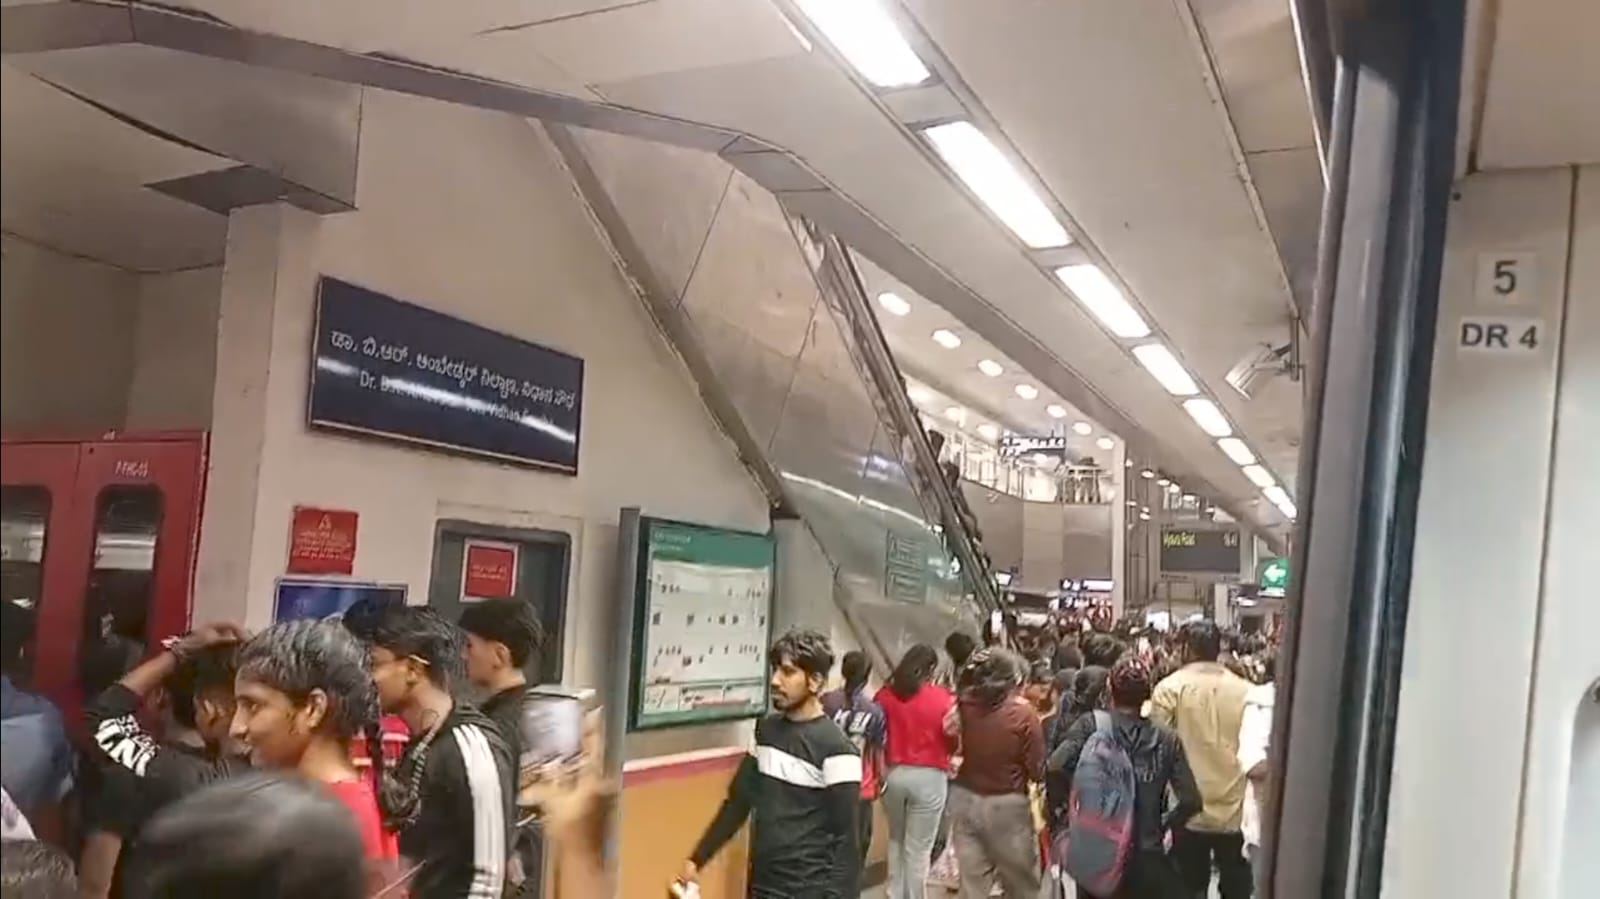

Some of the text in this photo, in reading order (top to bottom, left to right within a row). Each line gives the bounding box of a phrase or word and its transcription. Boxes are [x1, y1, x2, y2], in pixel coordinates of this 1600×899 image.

[1494, 260, 1518, 295] 5
[1460, 322, 1539, 350] DR 4
[360, 369, 377, 391] Dr.
